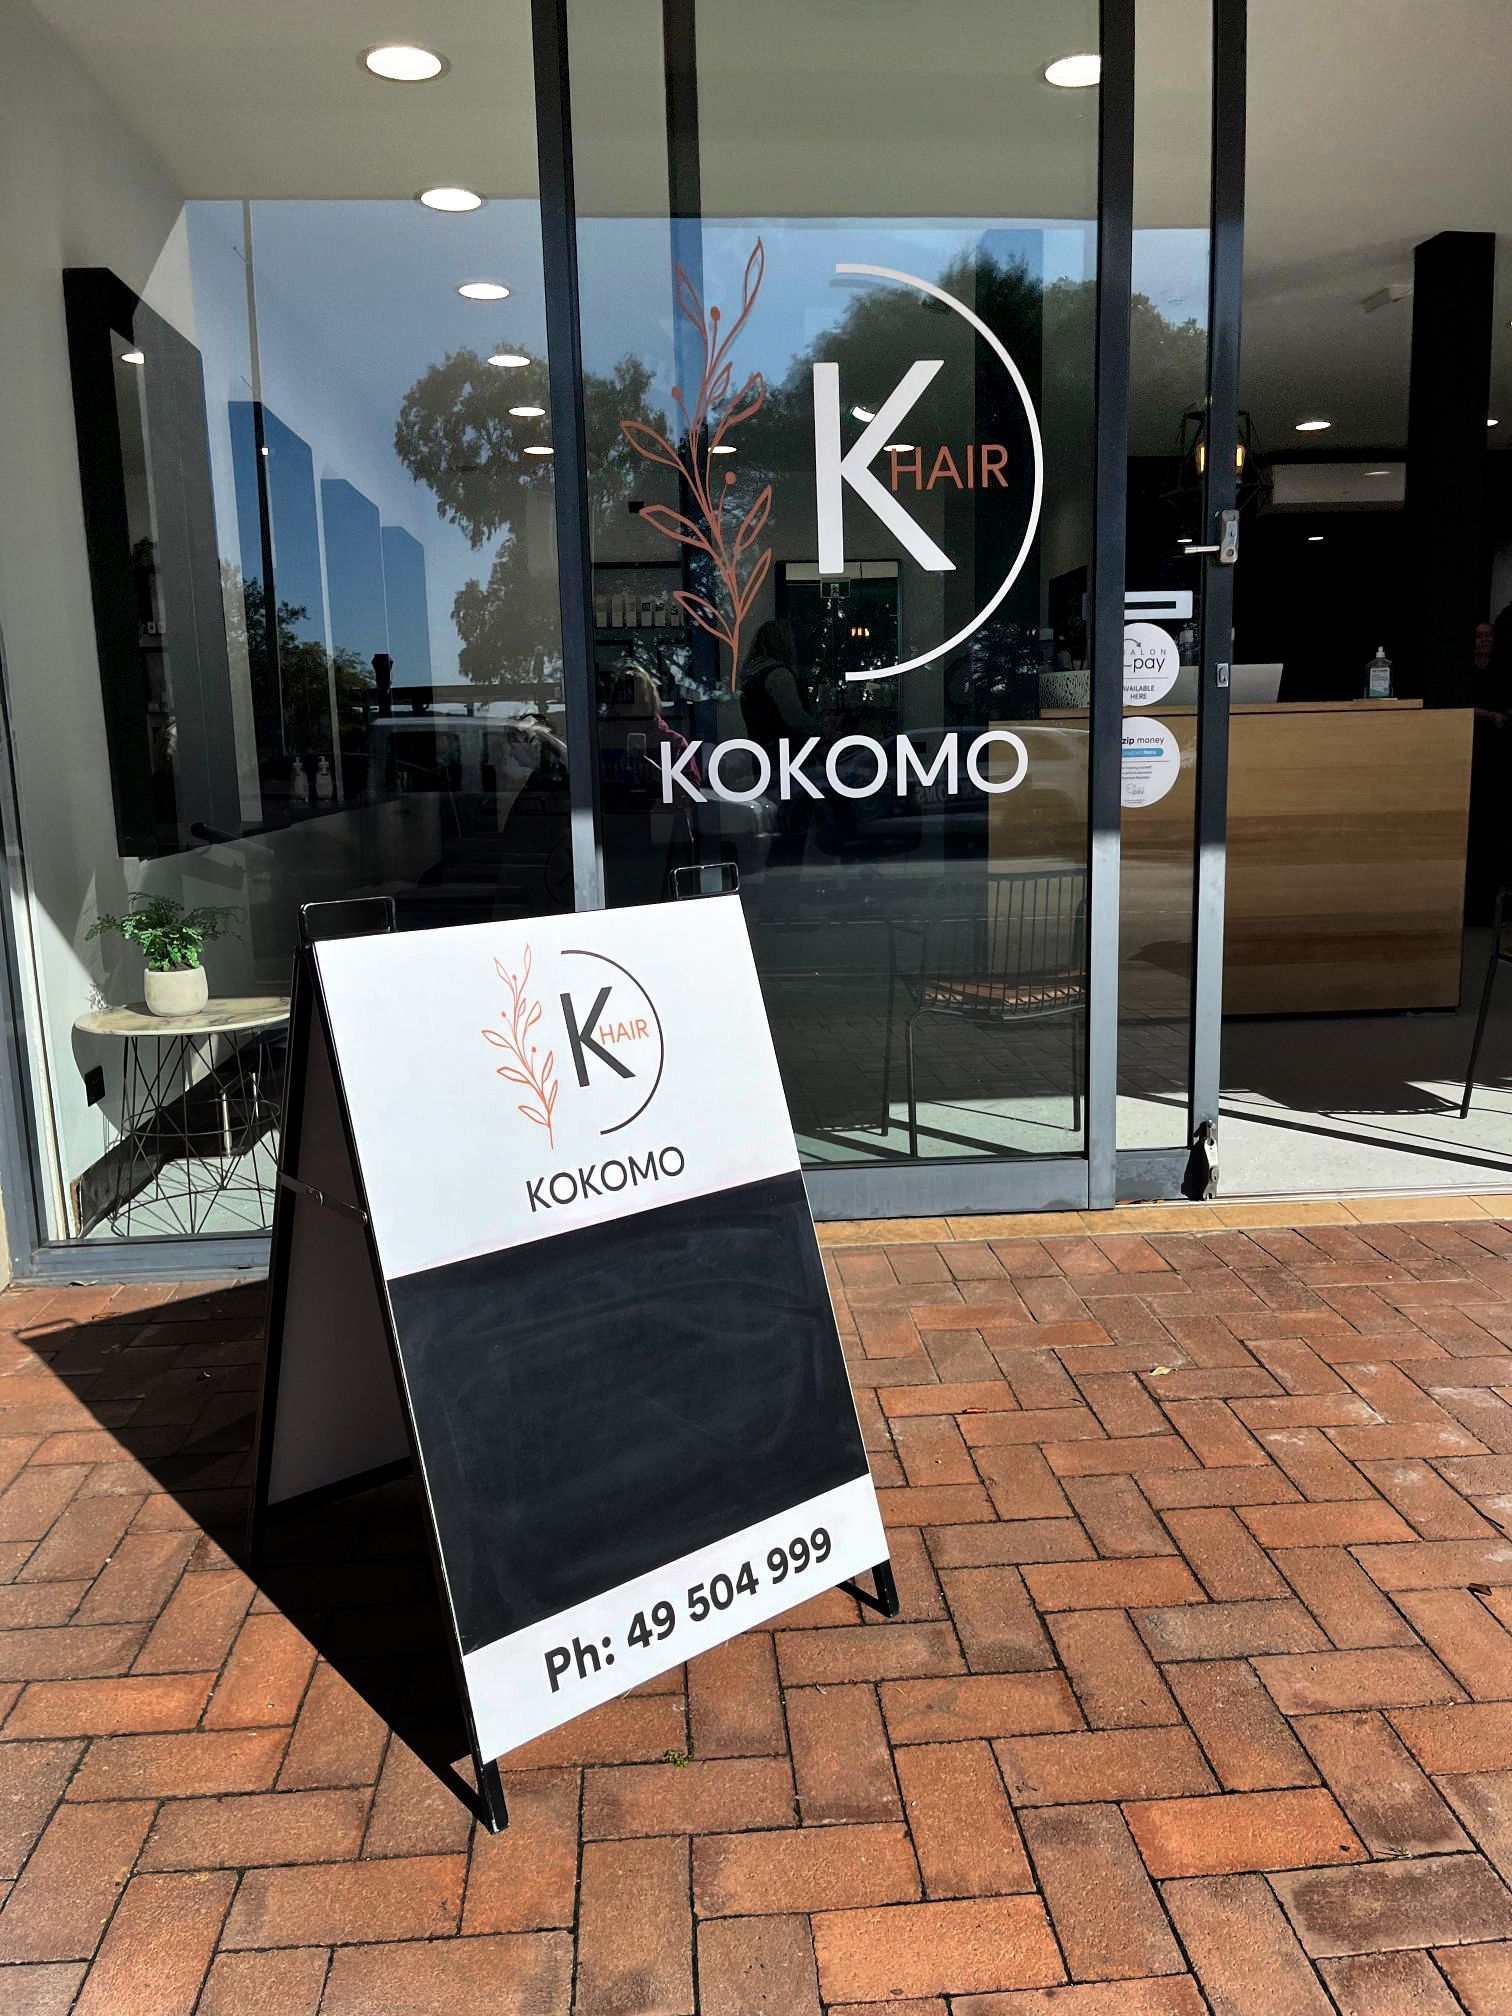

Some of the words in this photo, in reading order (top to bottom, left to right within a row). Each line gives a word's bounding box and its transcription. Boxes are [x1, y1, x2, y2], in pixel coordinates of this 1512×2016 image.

[891, 445, 1009, 491] HAIR
[1134, 657, 1165, 672] pay
[660, 730, 1030, 804] KOKOMO
[599, 1018, 650, 1045] HAIR
[526, 1146, 685, 1212] KOKOMO
[544, 1636, 615, 1693] Ph:
[627, 1600, 676, 1648] 49
[687, 1561, 760, 1622] 504
[766, 1527, 832, 1585] 999
